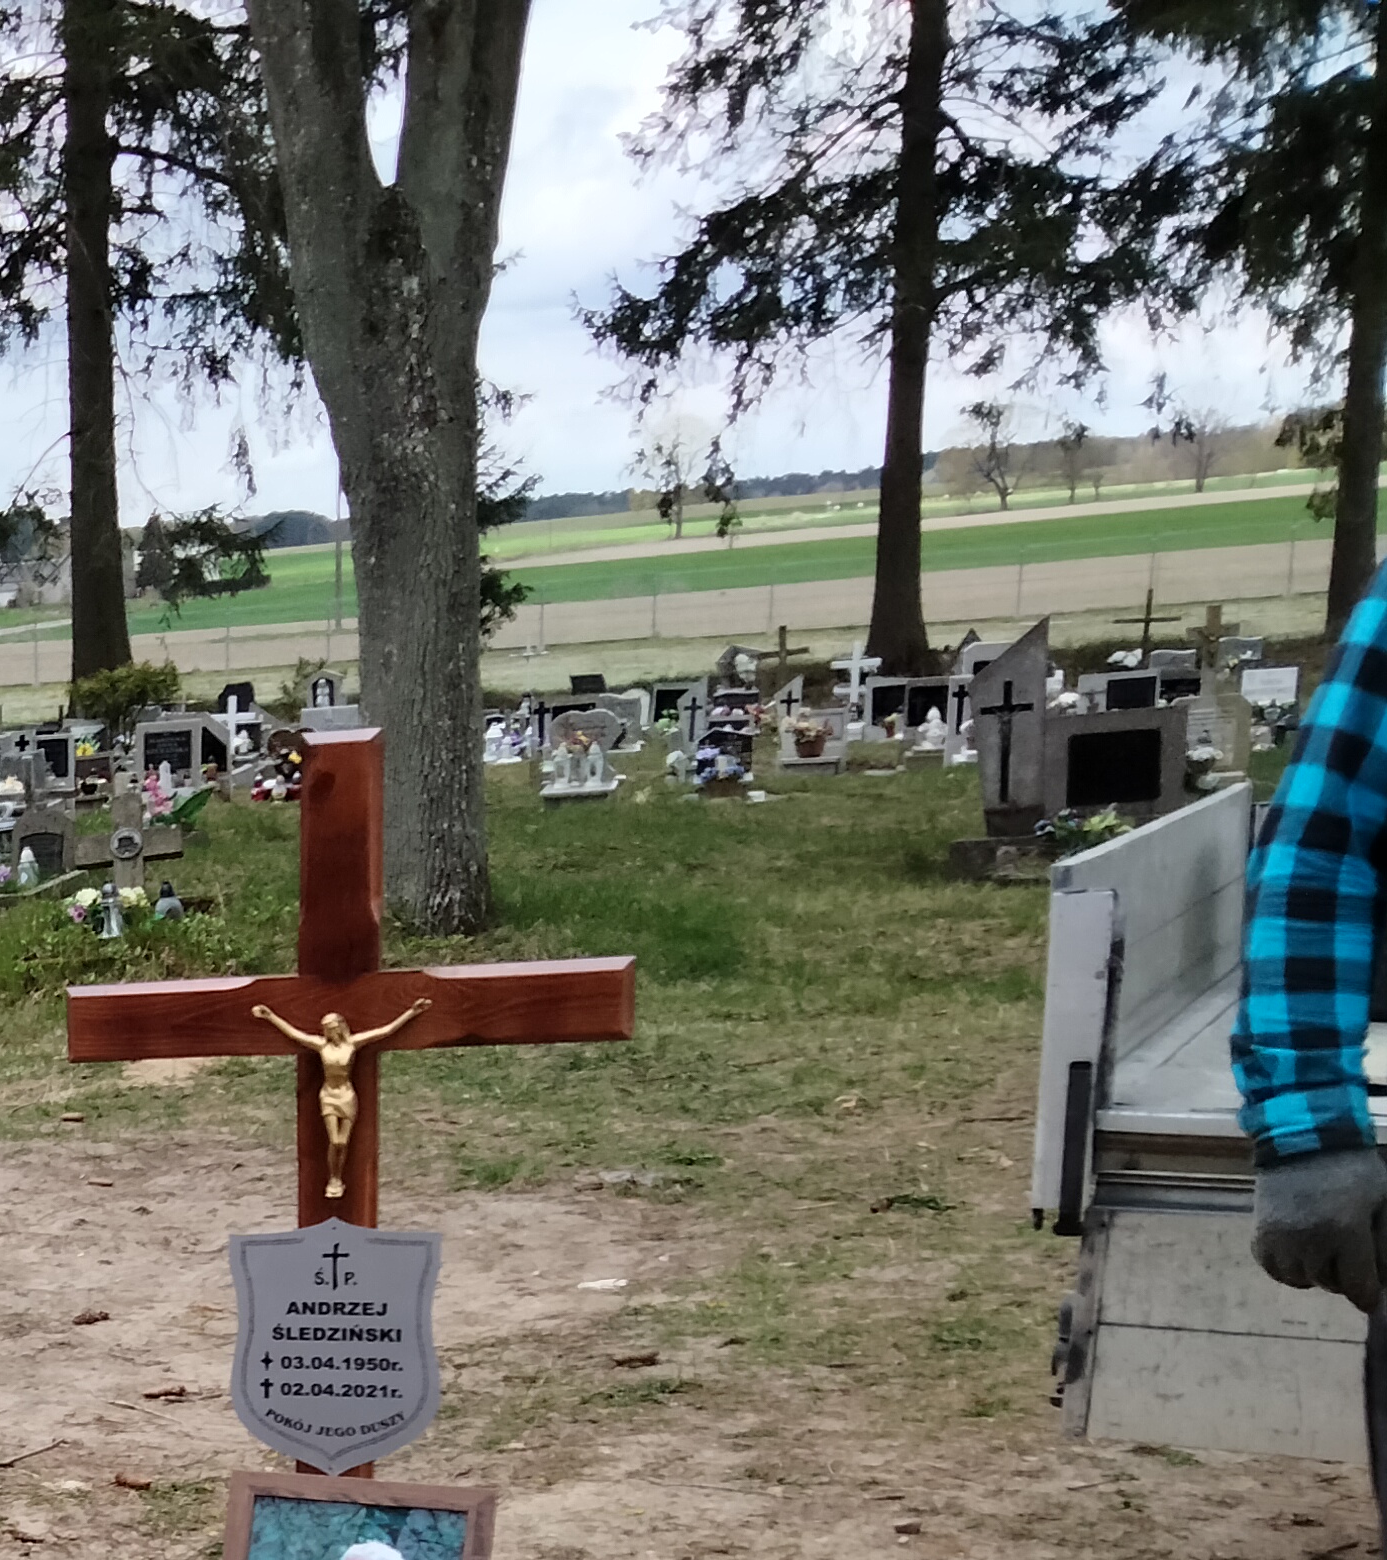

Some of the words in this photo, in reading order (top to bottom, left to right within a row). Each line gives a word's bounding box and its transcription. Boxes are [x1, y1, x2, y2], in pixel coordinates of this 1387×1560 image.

[285, 1301, 388, 1317] ANDRZEJ
[271, 1323, 402, 1343] ŚLEDZIŃSKI
[280, 1356, 404, 1372] 03.04.1950r.
[280, 1382, 403, 1399] 02.04.2021r.
[265, 1408, 313, 1434] POKÓJ
[315, 1425, 357, 1438] JEGO
[359, 1410, 406, 1436] DUSZY
